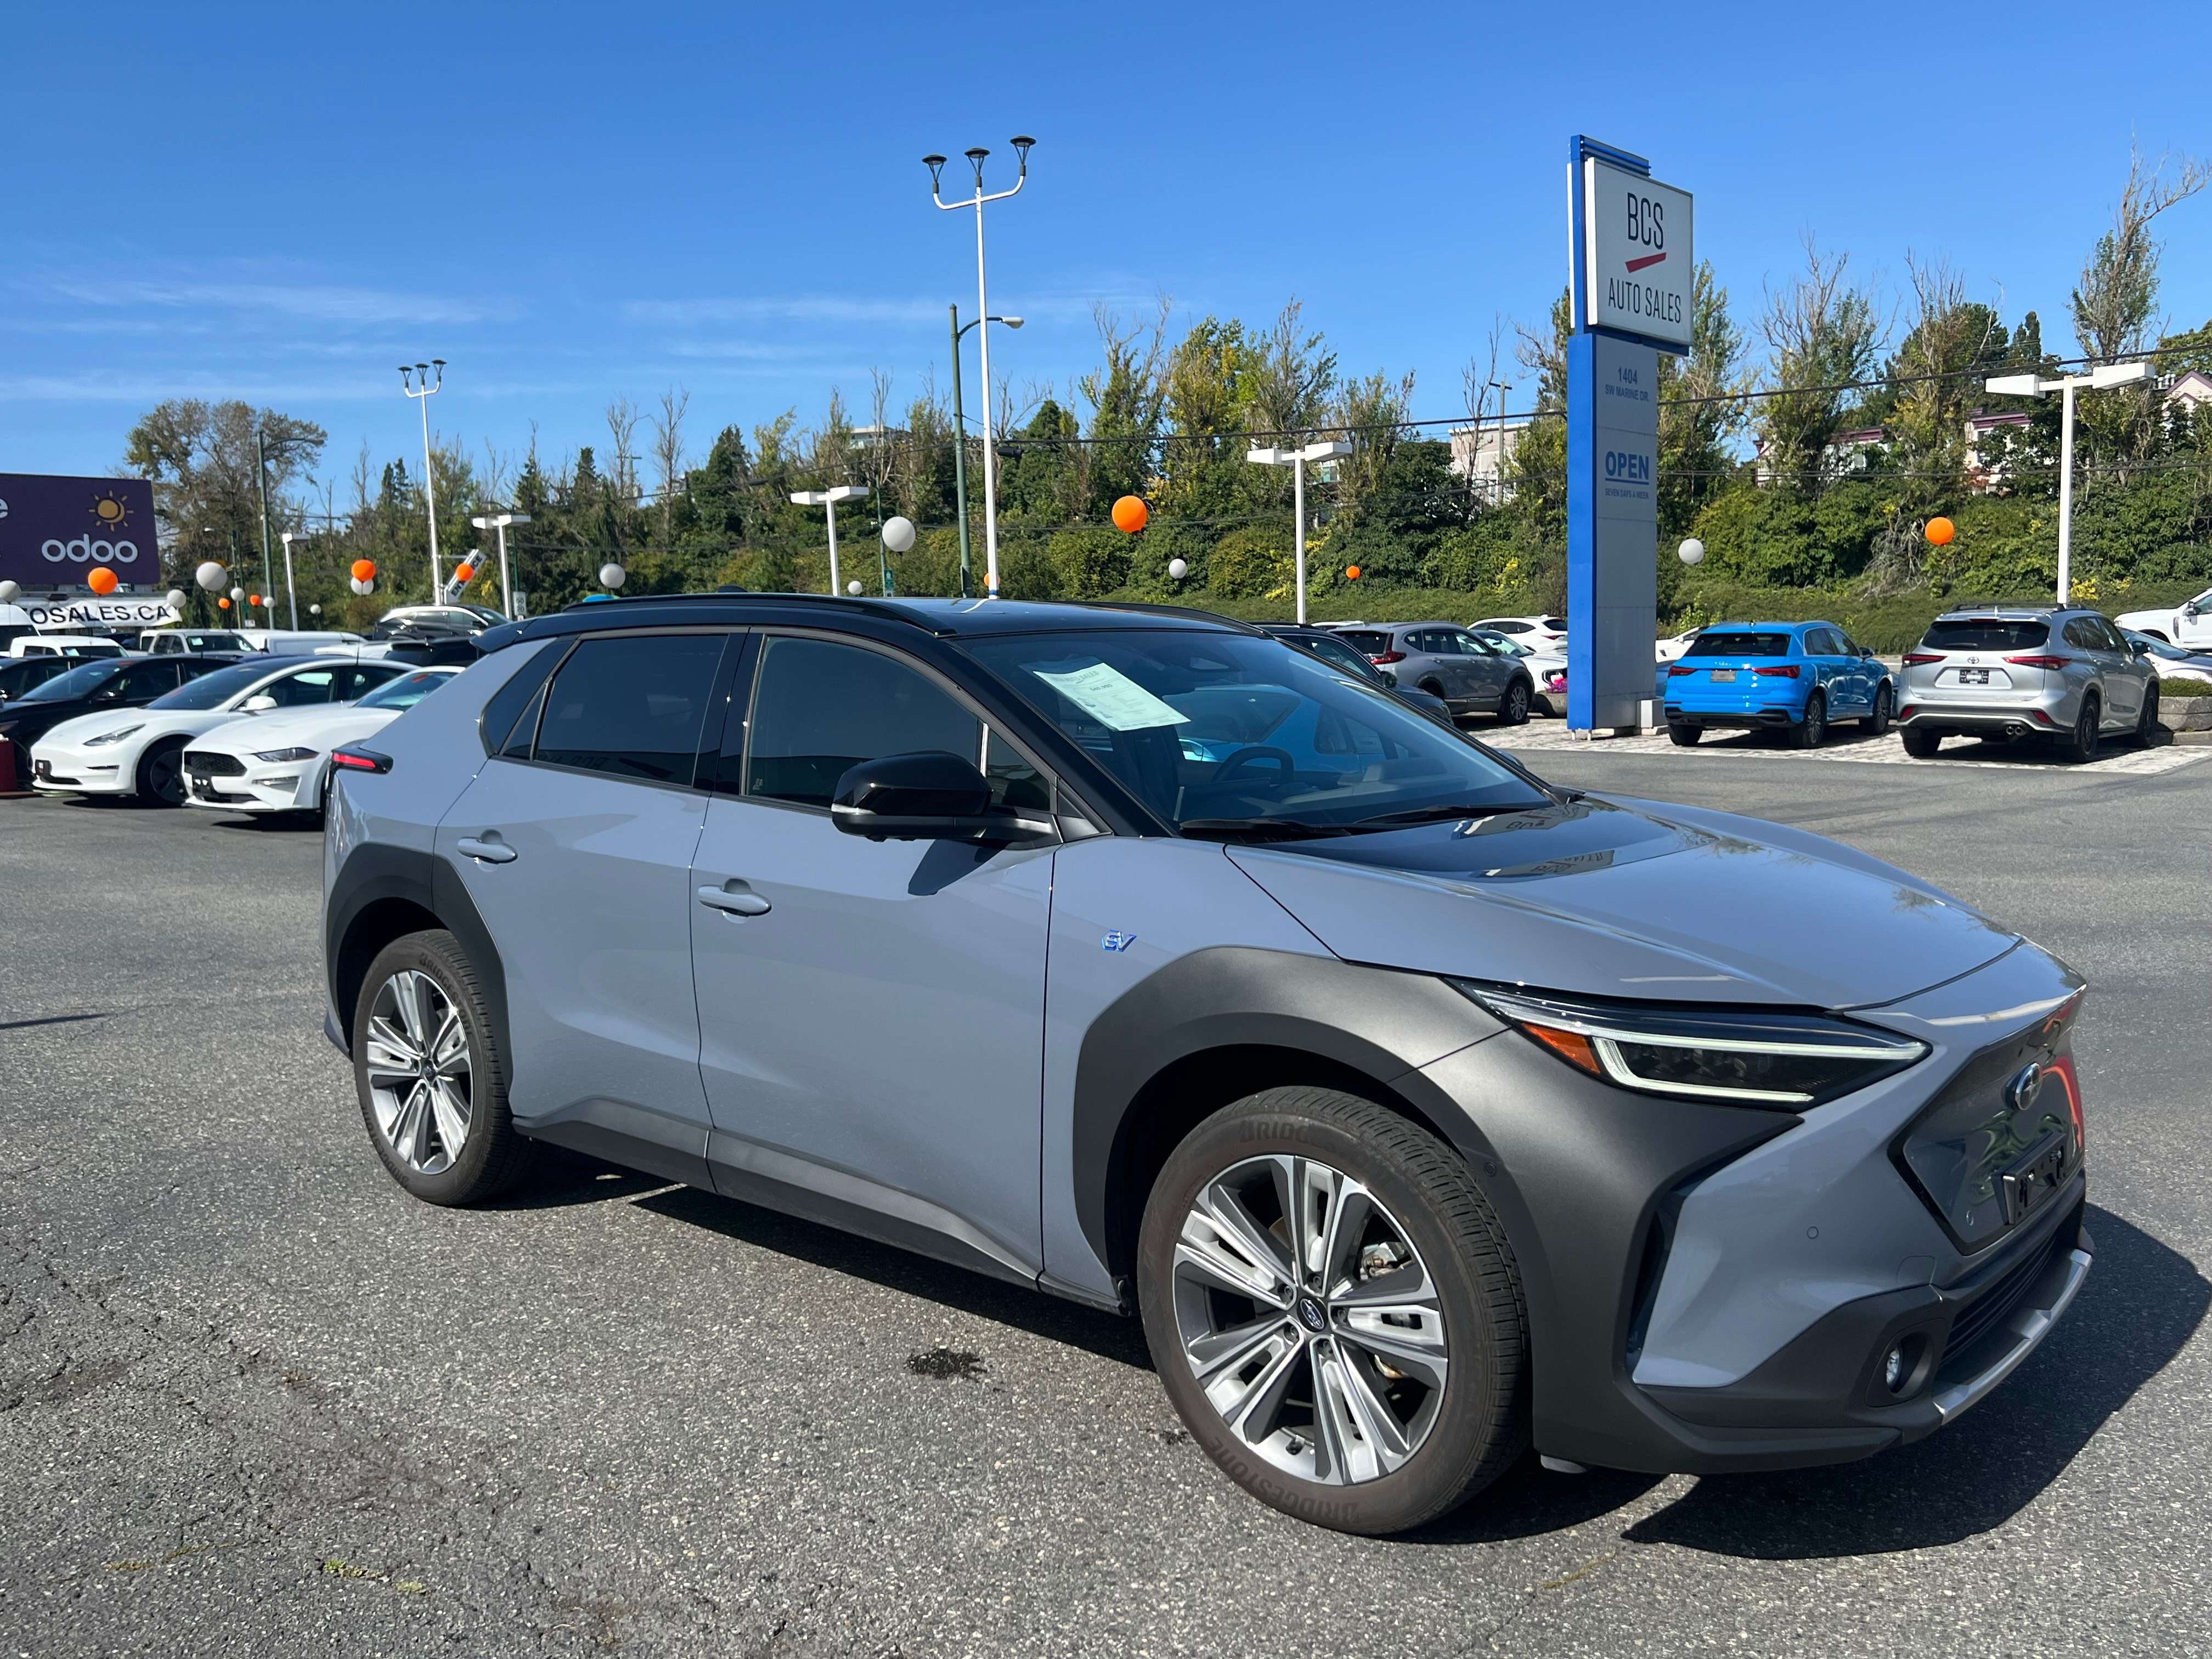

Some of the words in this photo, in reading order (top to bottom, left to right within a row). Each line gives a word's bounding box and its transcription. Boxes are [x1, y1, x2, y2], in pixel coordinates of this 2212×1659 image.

[1627, 192, 1663, 250] BCS
[1609, 278, 1640, 314] AUTO
[1645, 287, 1681, 324] SALES
[1618, 366, 1638, 385] 1404
[1605, 385, 1615, 396] SW
[1616, 386, 1639, 400] MARINE
[1640, 391, 1649, 402] DR
[1605, 451, 1649, 479] OPEN
[42, 533, 138, 562] odoo
